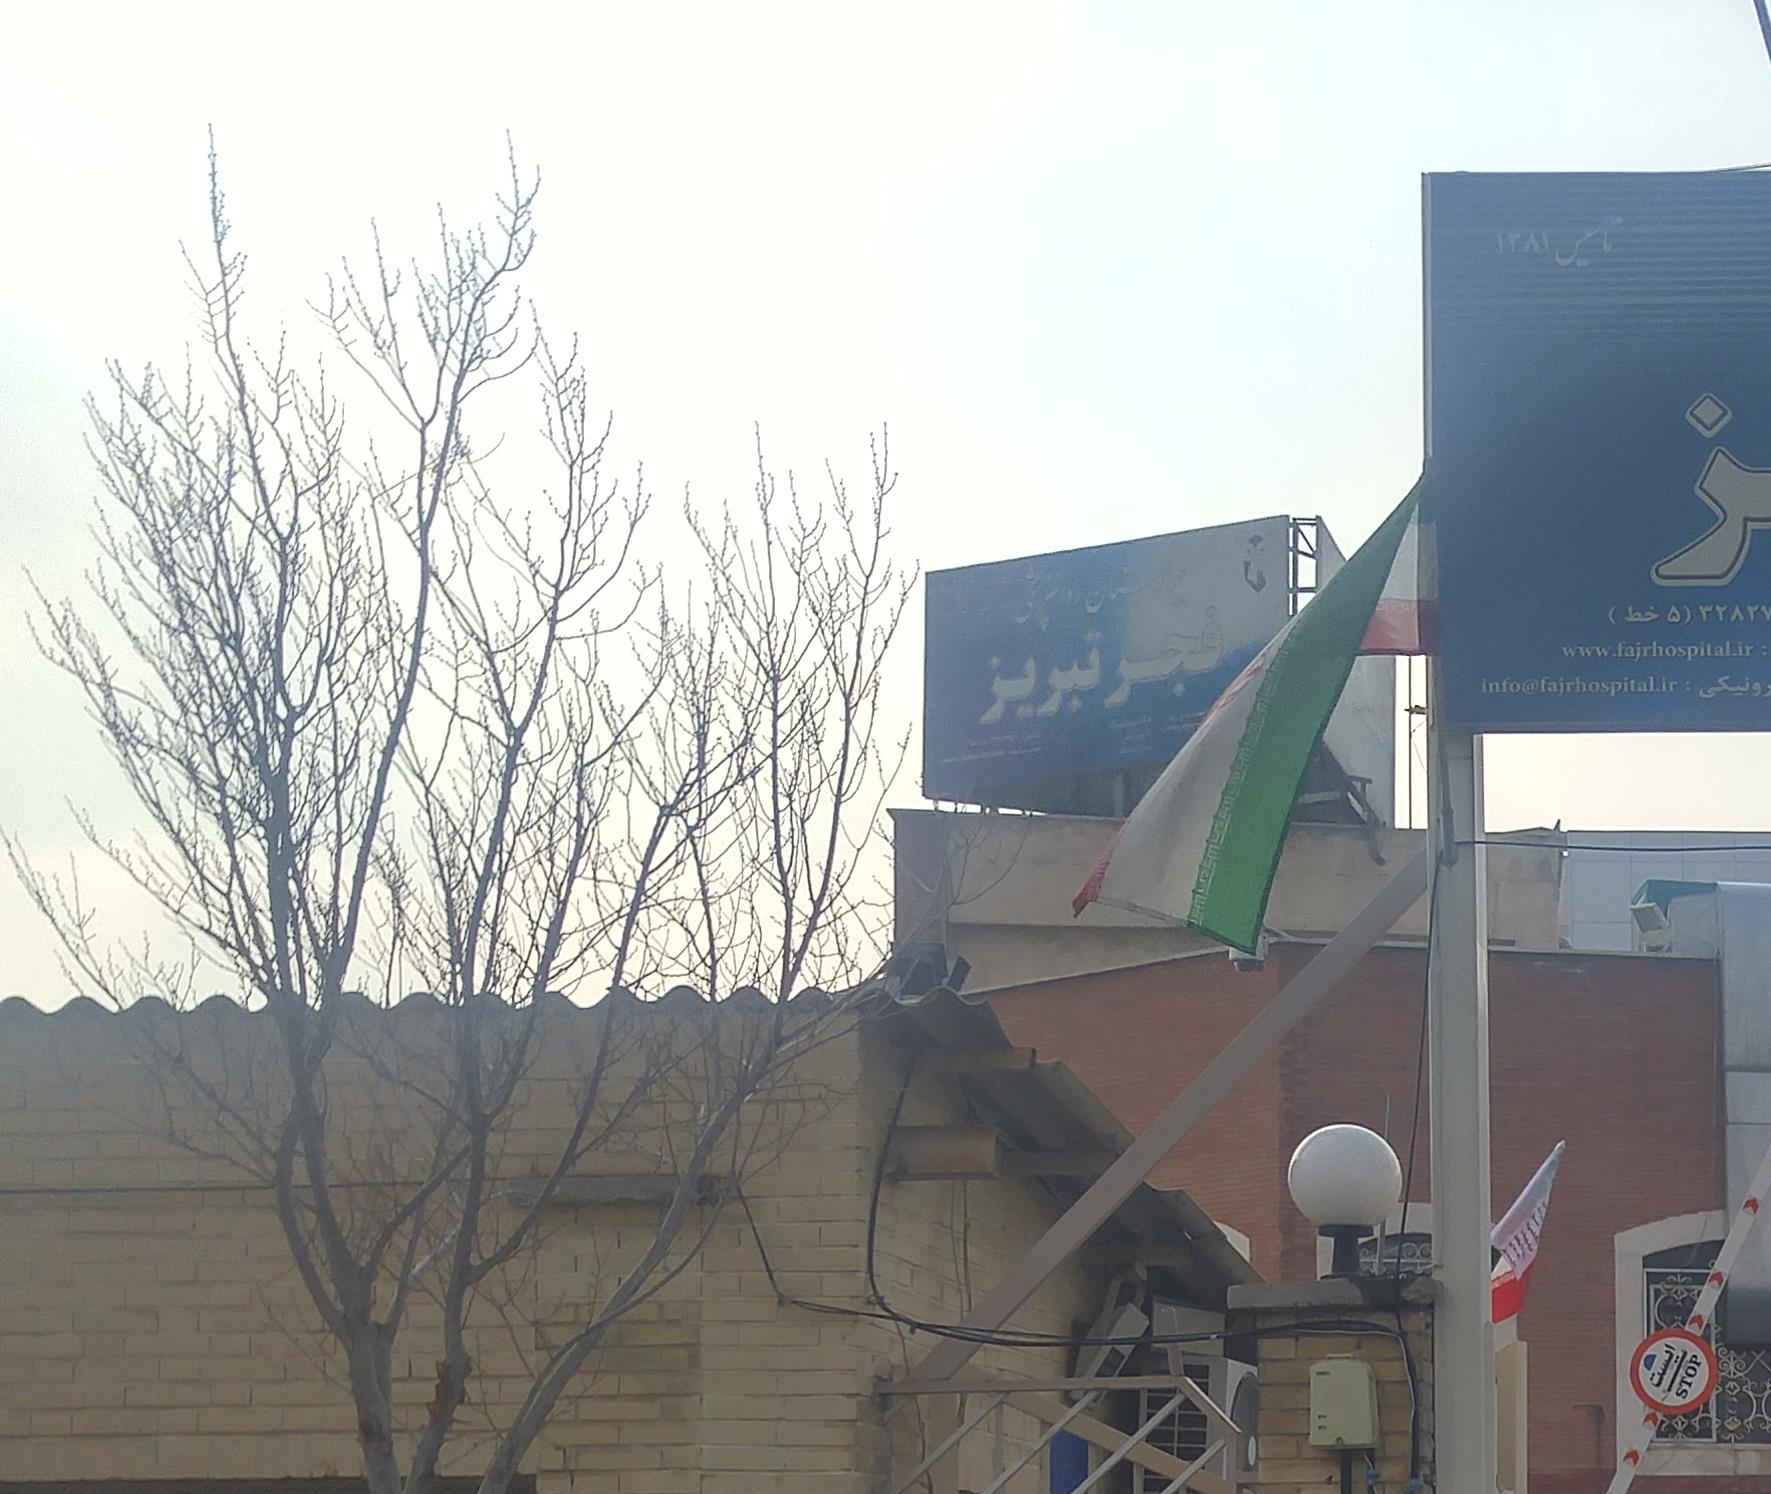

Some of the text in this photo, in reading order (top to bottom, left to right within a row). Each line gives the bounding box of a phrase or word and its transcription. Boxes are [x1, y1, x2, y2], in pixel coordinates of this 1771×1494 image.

[1624, 605, 1660, 622] خط
[977, 604, 1225, 725] فجر تبریز
[1562, 640, 1753, 662] www.fajrhospital.ir
[1481, 675, 1678, 697] info@fajrhospital.ir
[1650, 1343, 1679, 1388] ایست
[1675, 1354, 1702, 1399] STOP
